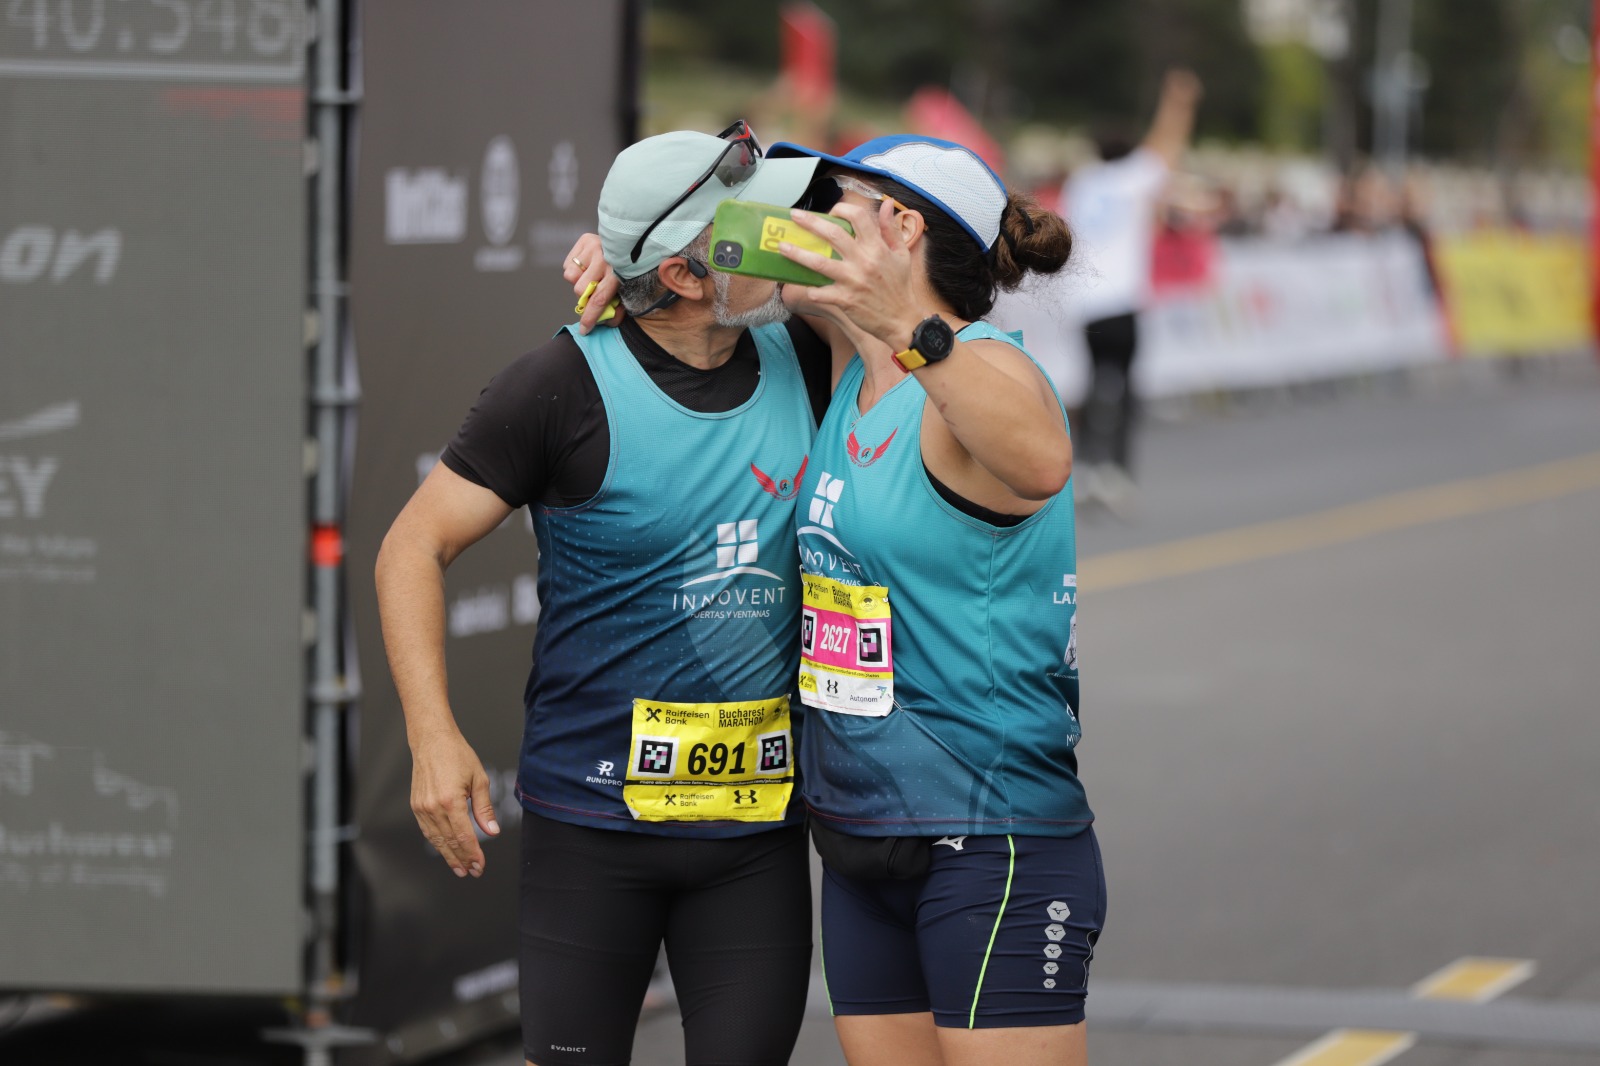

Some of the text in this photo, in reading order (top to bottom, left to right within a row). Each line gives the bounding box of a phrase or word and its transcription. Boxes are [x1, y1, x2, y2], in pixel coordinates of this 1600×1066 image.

[672, 586, 786, 612] INNOVENT
[726, 610, 732, 618] Y
[733, 609, 770, 618] VENTANAS
[820, 623, 851, 654] 2627
[849, 694, 878, 703] Autonom
[666, 709, 710, 719] Raiffeisen
[719, 707, 765, 719] Bucharest
[666, 717, 687, 726] Bank
[718, 717, 764, 728] MARATHON
[687, 742, 746, 776] 691
[551, 1044, 586, 1053] EVADICT
